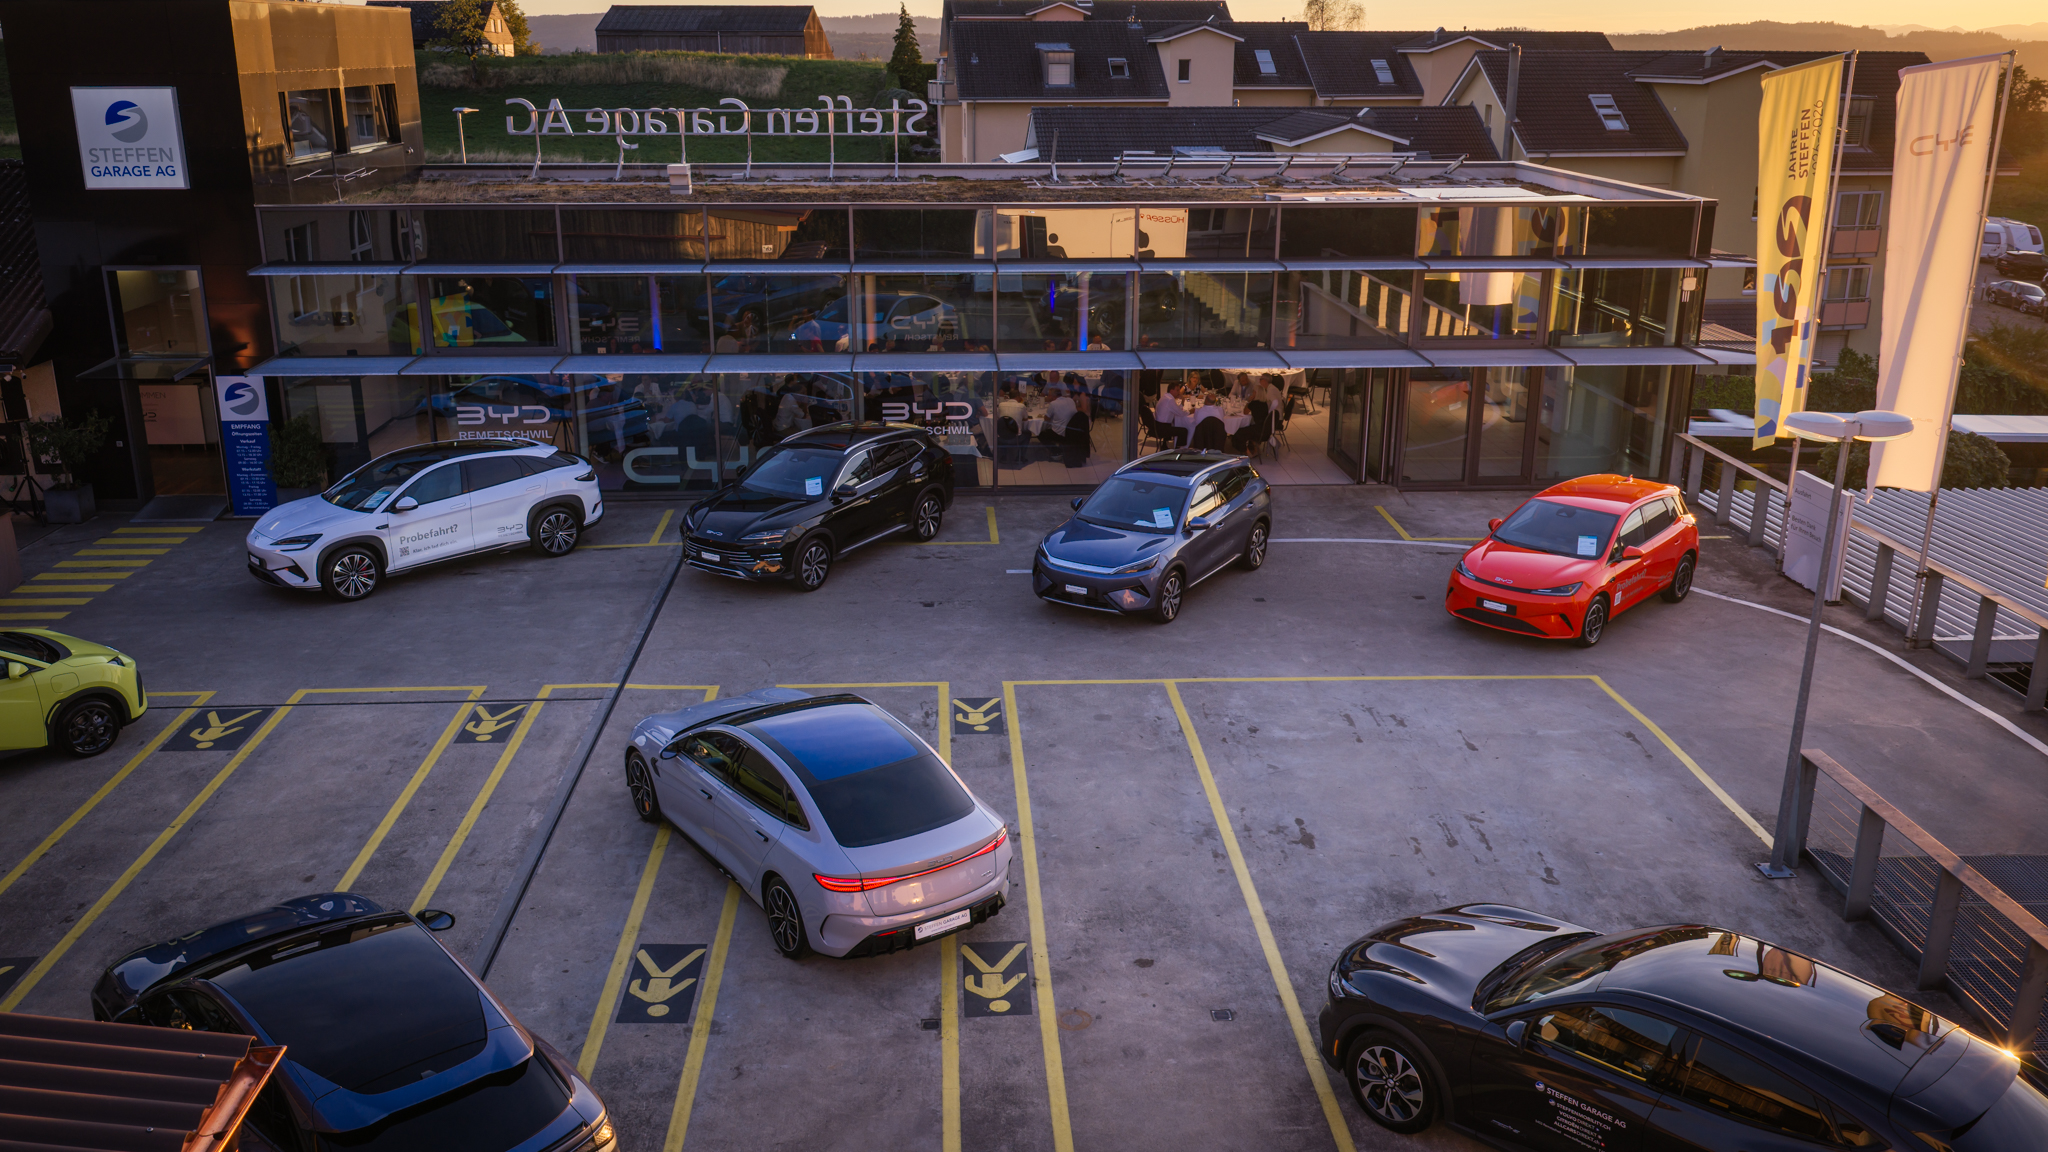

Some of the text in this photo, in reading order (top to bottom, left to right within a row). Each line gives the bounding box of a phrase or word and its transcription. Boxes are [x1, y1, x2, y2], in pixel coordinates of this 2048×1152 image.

[1798, 108, 1811, 179] STEFFEN
[88, 147, 174, 163] STEFFEN
[1788, 128, 1799, 180] JAHRE
[91, 165, 176, 177] GARAGE AG
[140, 391, 167, 400] MMEN
[456, 405, 551, 425] BYD
[881, 401, 973, 421] BYD
[458, 429, 553, 440] REMETSCHWIL
[1795, 487, 1812, 500] Ausfahrt
[399, 523, 459, 545] Probefahrt?
[497, 523, 524, 534] BYD
[924, 922, 943, 931] STEFFEN
[942, 916, 961, 925] GARAGE
[1546, 1087, 1627, 1129] STEFFEN GARAGE AG
